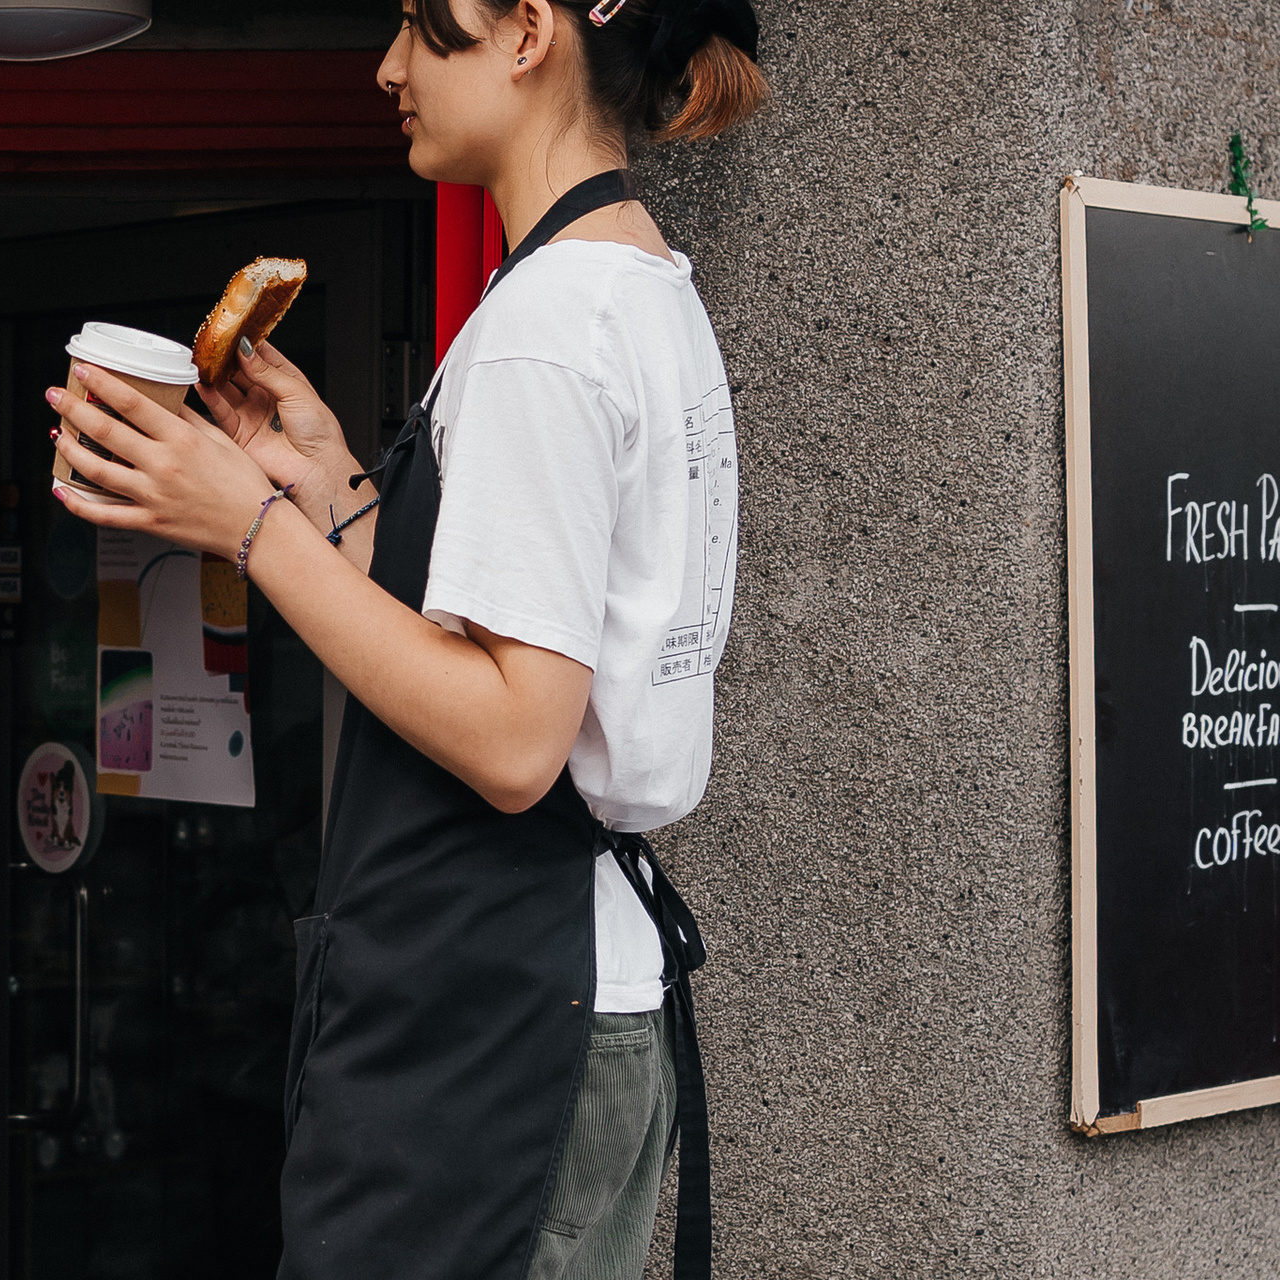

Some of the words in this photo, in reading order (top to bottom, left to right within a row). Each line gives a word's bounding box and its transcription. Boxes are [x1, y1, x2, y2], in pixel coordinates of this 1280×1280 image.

[1166, 473, 1248, 563] FRESH
[661, 631, 699, 652] 味期限
[1190, 636, 1280, 696] Delicio
